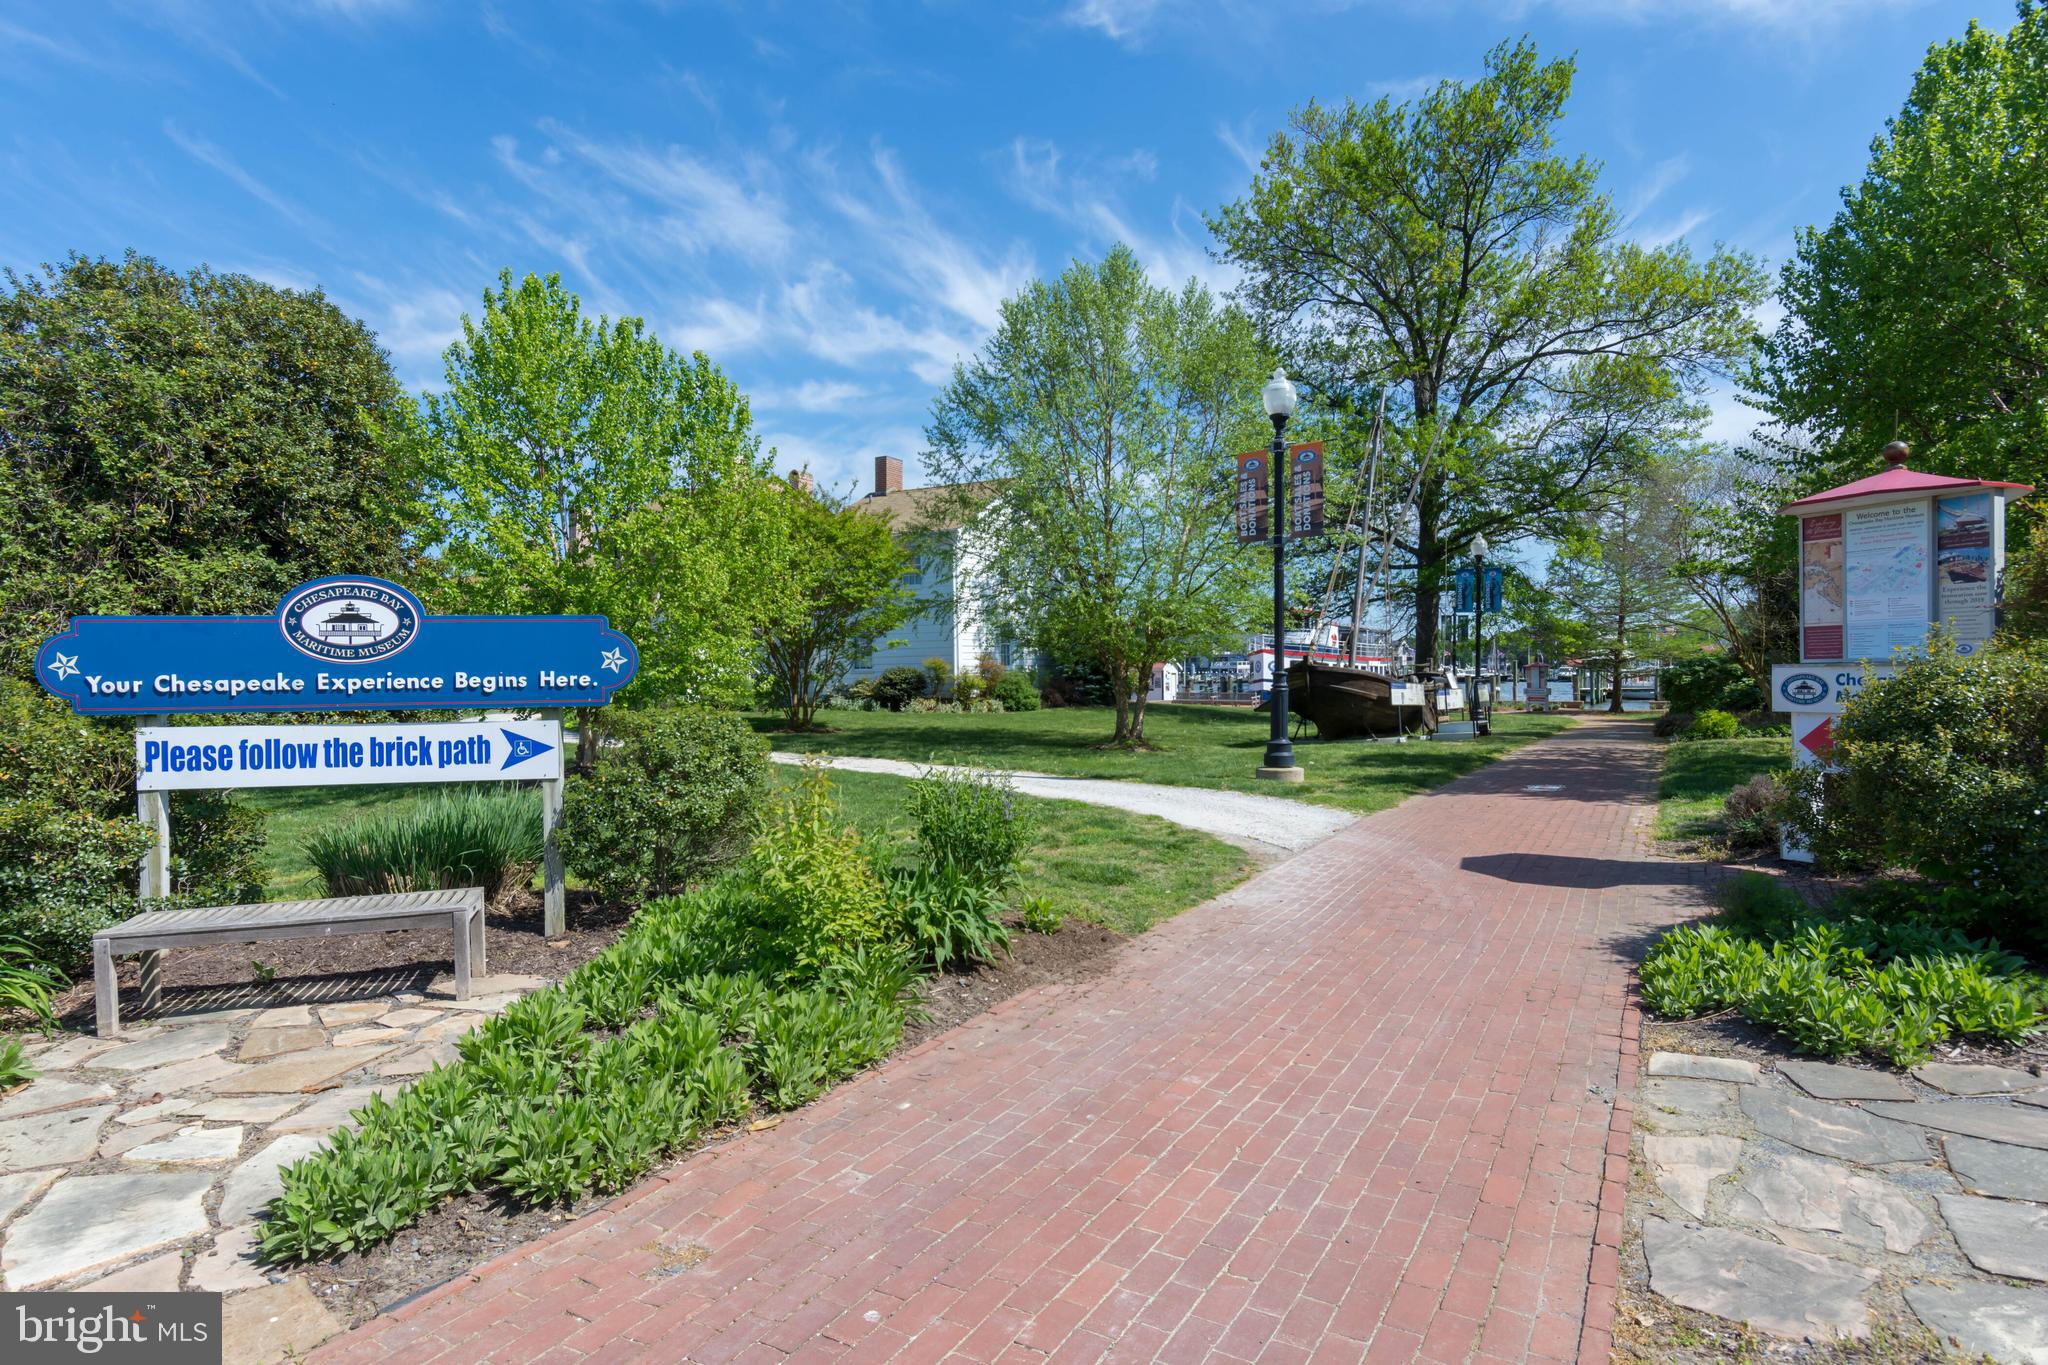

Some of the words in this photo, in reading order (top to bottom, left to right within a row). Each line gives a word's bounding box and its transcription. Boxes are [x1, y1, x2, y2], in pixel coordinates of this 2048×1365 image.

[1248, 478, 1256, 536] DONATIONS
[1303, 471, 1311, 531] DONATIONS
[1856, 510, 1890, 520] Welcome
[1903, 506, 1916, 514] the
[294, 587, 378, 613] CHESAPEAKE
[380, 593, 404, 611] BAY
[293, 630, 355, 657] MARITIME
[358, 628, 411, 657] MUSEUM
[85, 675, 143, 694] Your
[154, 672, 305, 696] Chesapeake
[317, 671, 444, 695] Experience
[455, 671, 528, 693] Begins
[540, 670, 598, 688] Here.
[144, 740, 233, 773] Please
[239, 738, 318, 770] follow
[323, 737, 364, 768] the
[370, 735, 433, 768] brick
[438, 734, 491, 769] path
